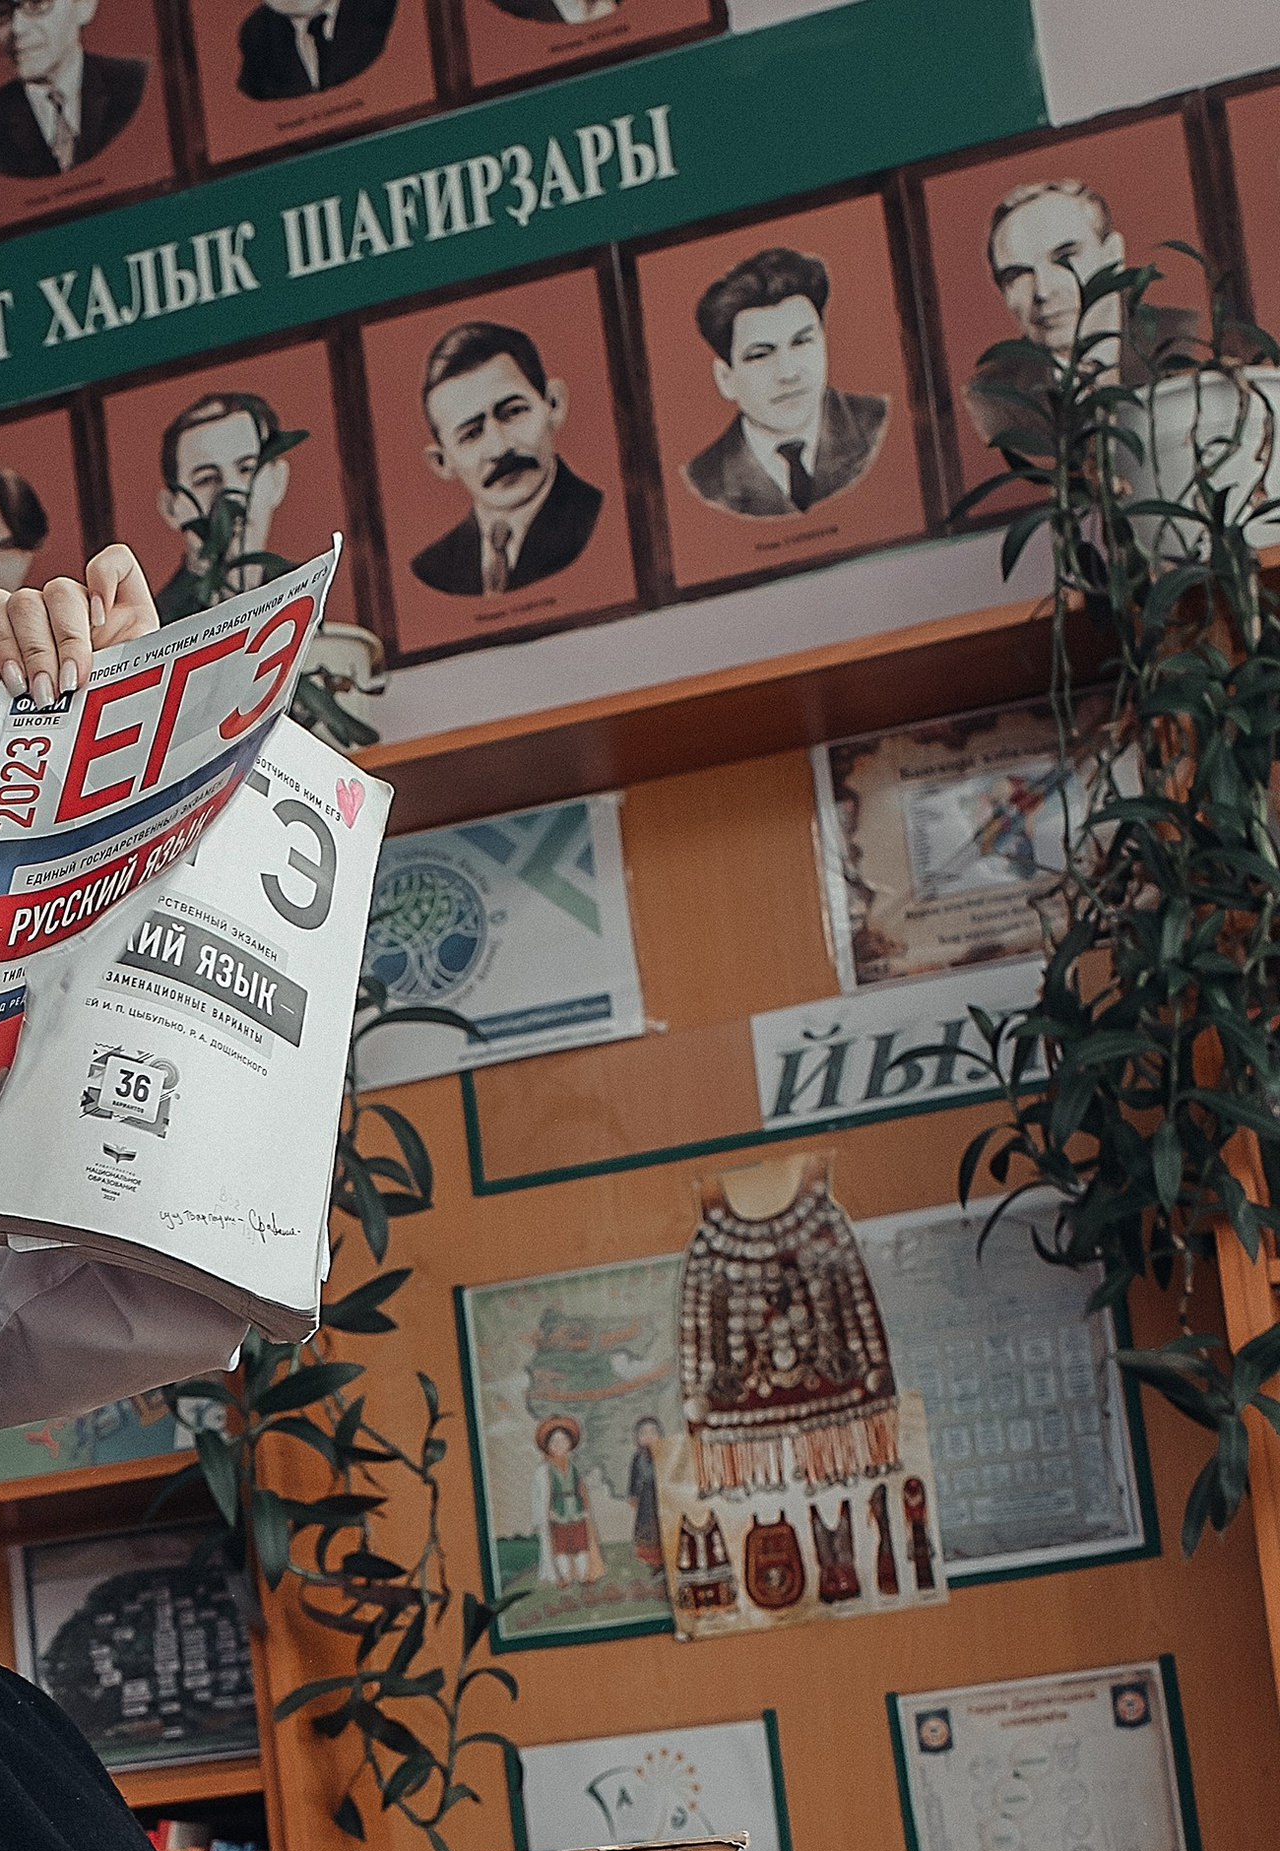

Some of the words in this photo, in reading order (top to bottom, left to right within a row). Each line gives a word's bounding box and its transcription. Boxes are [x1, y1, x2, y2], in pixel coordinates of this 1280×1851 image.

[88, 660, 129, 683] ПРОЕКТ
[133, 656, 141, 668] С
[144, 633, 199, 665] УЧАСТИЕМ
[202, 593, 285, 641] РАЗРАБОТЧИКОВ
[287, 580, 310, 600] КИМ
[12, 716, 61, 727] ШКОЛЕ
[16, 696, 67, 712] ФИ
[53, 594, 317, 825] ЕГЭ
[303, 789, 324, 810] КИМ
[325, 803, 342, 823] ЕГЭ
[6, 852, 140, 948] РУССКИЙ
[136, 804, 216, 888] ЯЗЫК
[25, 860, 78, 886] ЕДИНЫЙ
[79, 808, 180, 870] ГОСУДАРСТВЕННЫЙ
[195, 943, 279, 1017] ЯЗЫК
[230, 926, 279, 963] ЭКЗАМЕН
[104, 970, 208, 1014] ЗАМЕНАЦИОННЫЕ
[211, 1007, 264, 1046] ВАРИАНТЫ
[128, 1007, 187, 1035] ЦЫБУЛЬКО,
[209, 1038, 270, 1078] ДОЩИНСКОГО
[115, 1068, 152, 1104] 36
